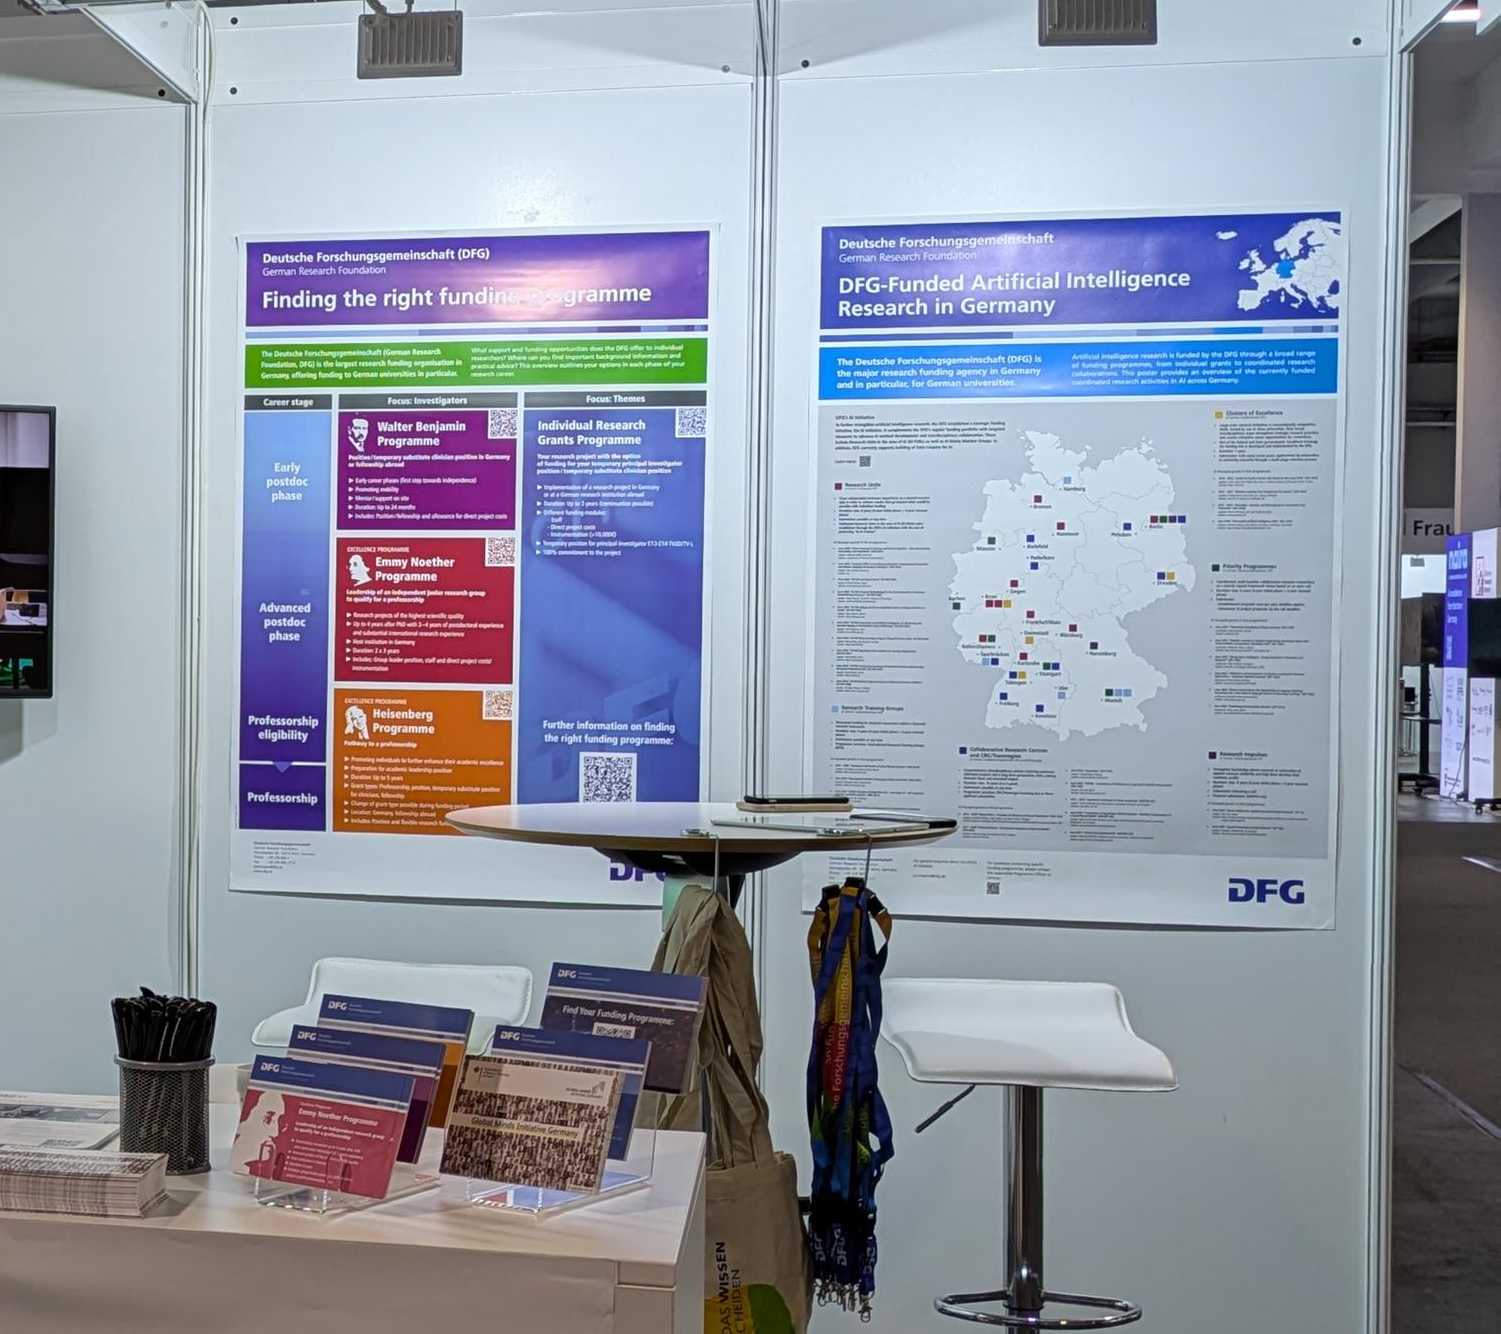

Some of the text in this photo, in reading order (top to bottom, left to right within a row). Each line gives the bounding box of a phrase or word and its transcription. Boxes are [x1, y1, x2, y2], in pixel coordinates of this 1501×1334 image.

[840, 233, 1054, 250] Deutsche Forschungsgemeinschaft
[263, 247, 489, 264] Deutsche Forschungsgemeinschaft (DFG)
[839, 270, 1190, 295] DFG-Funded Artificial Intelligence
[262, 289, 337, 313] Finding
[343, 289, 377, 308] the
[383, 287, 433, 309] right
[439, 286, 519, 309] funding
[839, 297, 1055, 318] Research in Germany
[378, 420, 466, 435] Walter Benjamin
[378, 435, 439, 448] Programme
[274, 462, 300, 476] Early
[266, 476, 307, 490] postdoc
[272, 489, 302, 503] phase
[376, 557, 454, 570] Emmy Noether
[375, 571, 437, 584] Programme
[248, 715, 318, 729] Professorship
[373, 709, 433, 724] Heisenberg
[258, 729, 308, 742] eligibility
[373, 723, 435, 737] Programme
[1228, 879, 1305, 904] DFG
[558, 969, 576, 978] DFG
[328, 1001, 347, 1010] DFG
[563, 1005, 674, 1025] Find Your Funding Programme:
[298, 1032, 316, 1041] DFG
[501, 1031, 520, 1041] DFG
[261, 1063, 279, 1073] DFG
[715, 1241, 729, 1303] WISSEN
